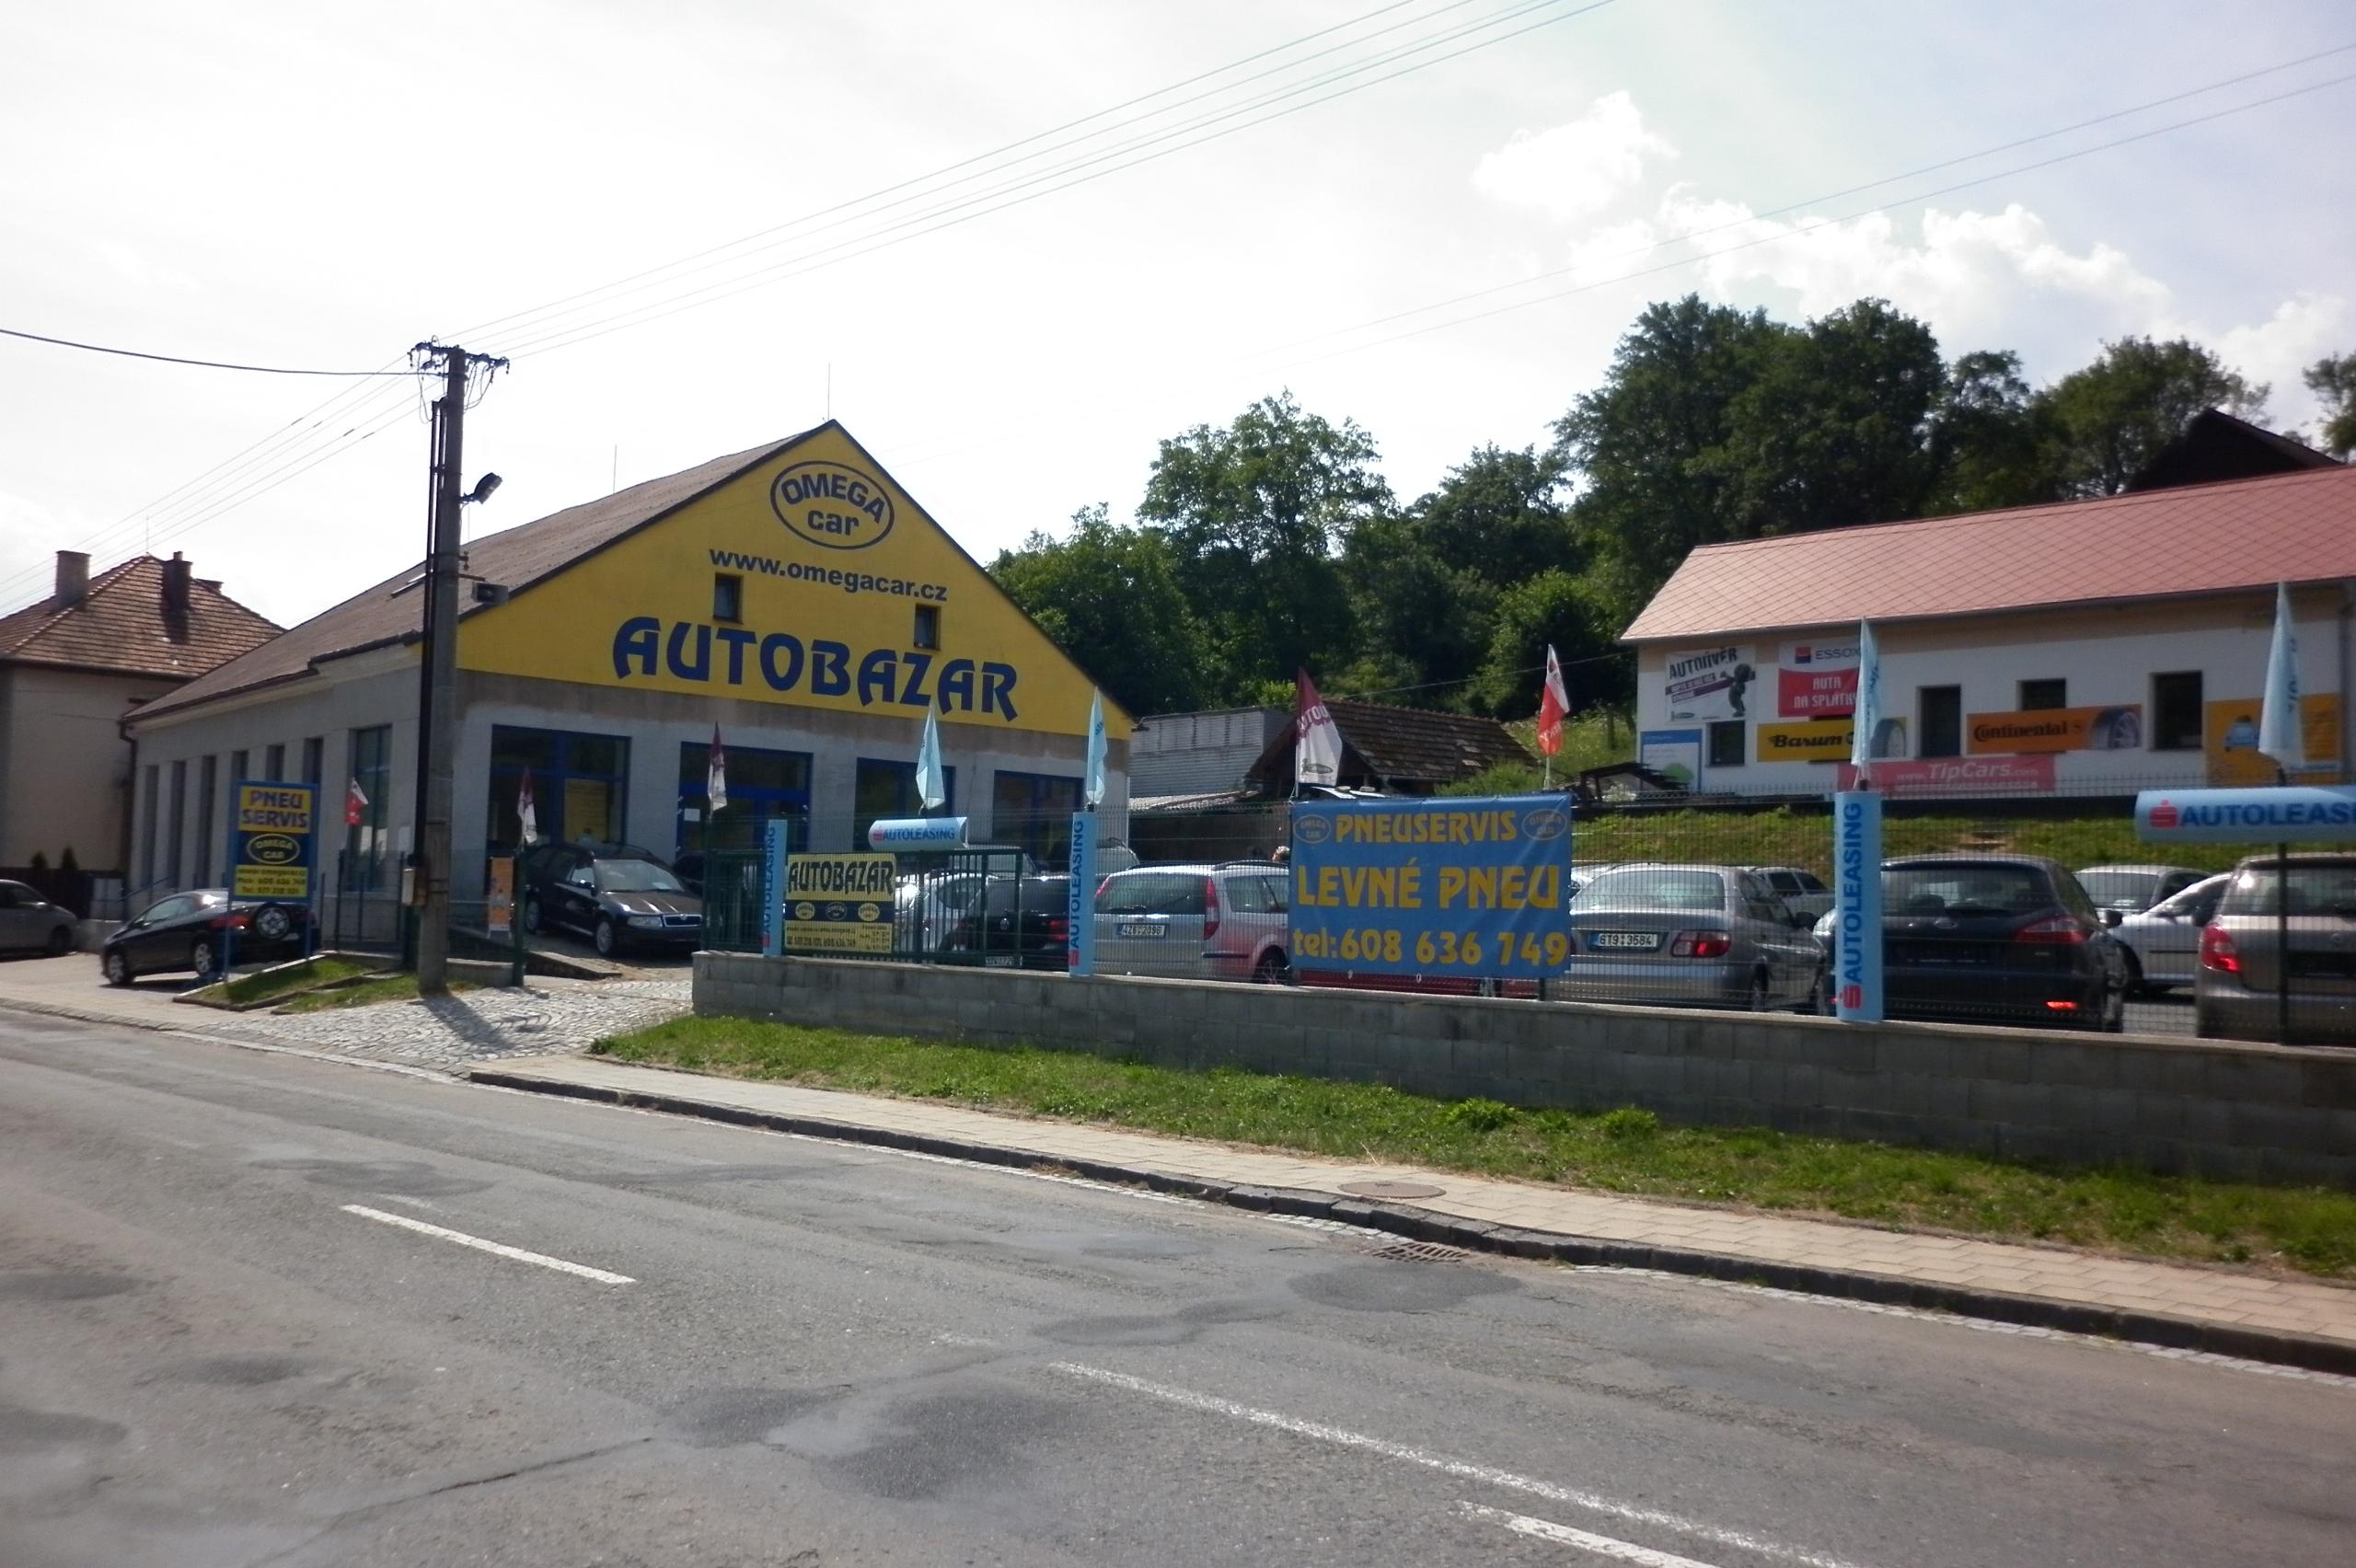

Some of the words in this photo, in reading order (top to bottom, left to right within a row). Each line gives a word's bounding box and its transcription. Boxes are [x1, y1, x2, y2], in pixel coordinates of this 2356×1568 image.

[780, 473, 886, 525] OMEGA
[807, 509, 860, 536] car
[709, 549, 948, 603] www.omegacar.cz
[612, 616, 1019, 723] AUTOBAZAR
[1813, 677, 1842, 690] AUTA
[1773, 734, 1843, 748] Barum
[1974, 720, 2069, 742] Continental
[249, 790, 304, 809] PNEU
[242, 809, 308, 828] SERVIS
[884, 827, 954, 840] AUTOLEASING
[1335, 811, 1517, 845] PNEUSERVIS
[764, 826, 777, 933] AUTOLEASING
[789, 860, 895, 896] AUTOBAZAR
[1070, 820, 1084, 949] AUTOLEASING
[1298, 858, 1422, 908] LEVNÉ
[1438, 865, 1560, 910] PNEU
[1844, 803, 1862, 984] AUTOLEASING
[1415, 929, 1483, 966] 636
[1497, 928, 1568, 967] 749
[1600, 934, 1619, 945] 6T9
